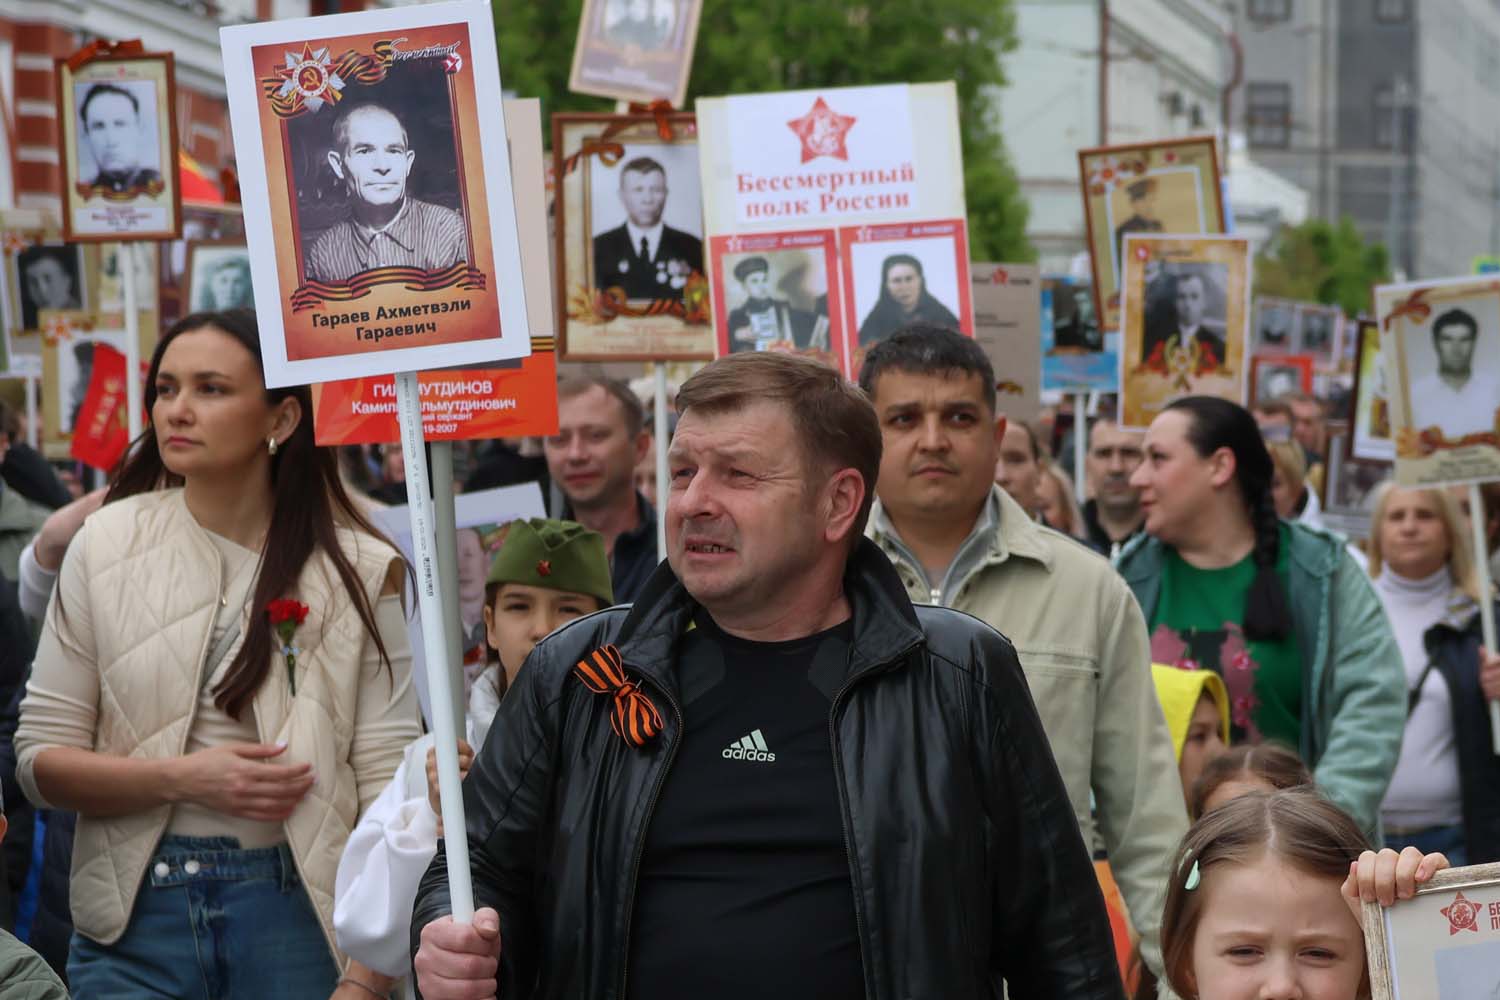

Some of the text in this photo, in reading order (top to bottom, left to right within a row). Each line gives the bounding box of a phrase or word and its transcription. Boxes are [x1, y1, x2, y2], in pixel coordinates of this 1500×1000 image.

[736, 162, 916, 193] Бессмертный
[746, 192, 911, 218] полк России
[312, 299, 472, 330] Гараев Ахметвэли
[355, 321, 437, 342] Гараевич
[722, 747, 776, 762] adidas
